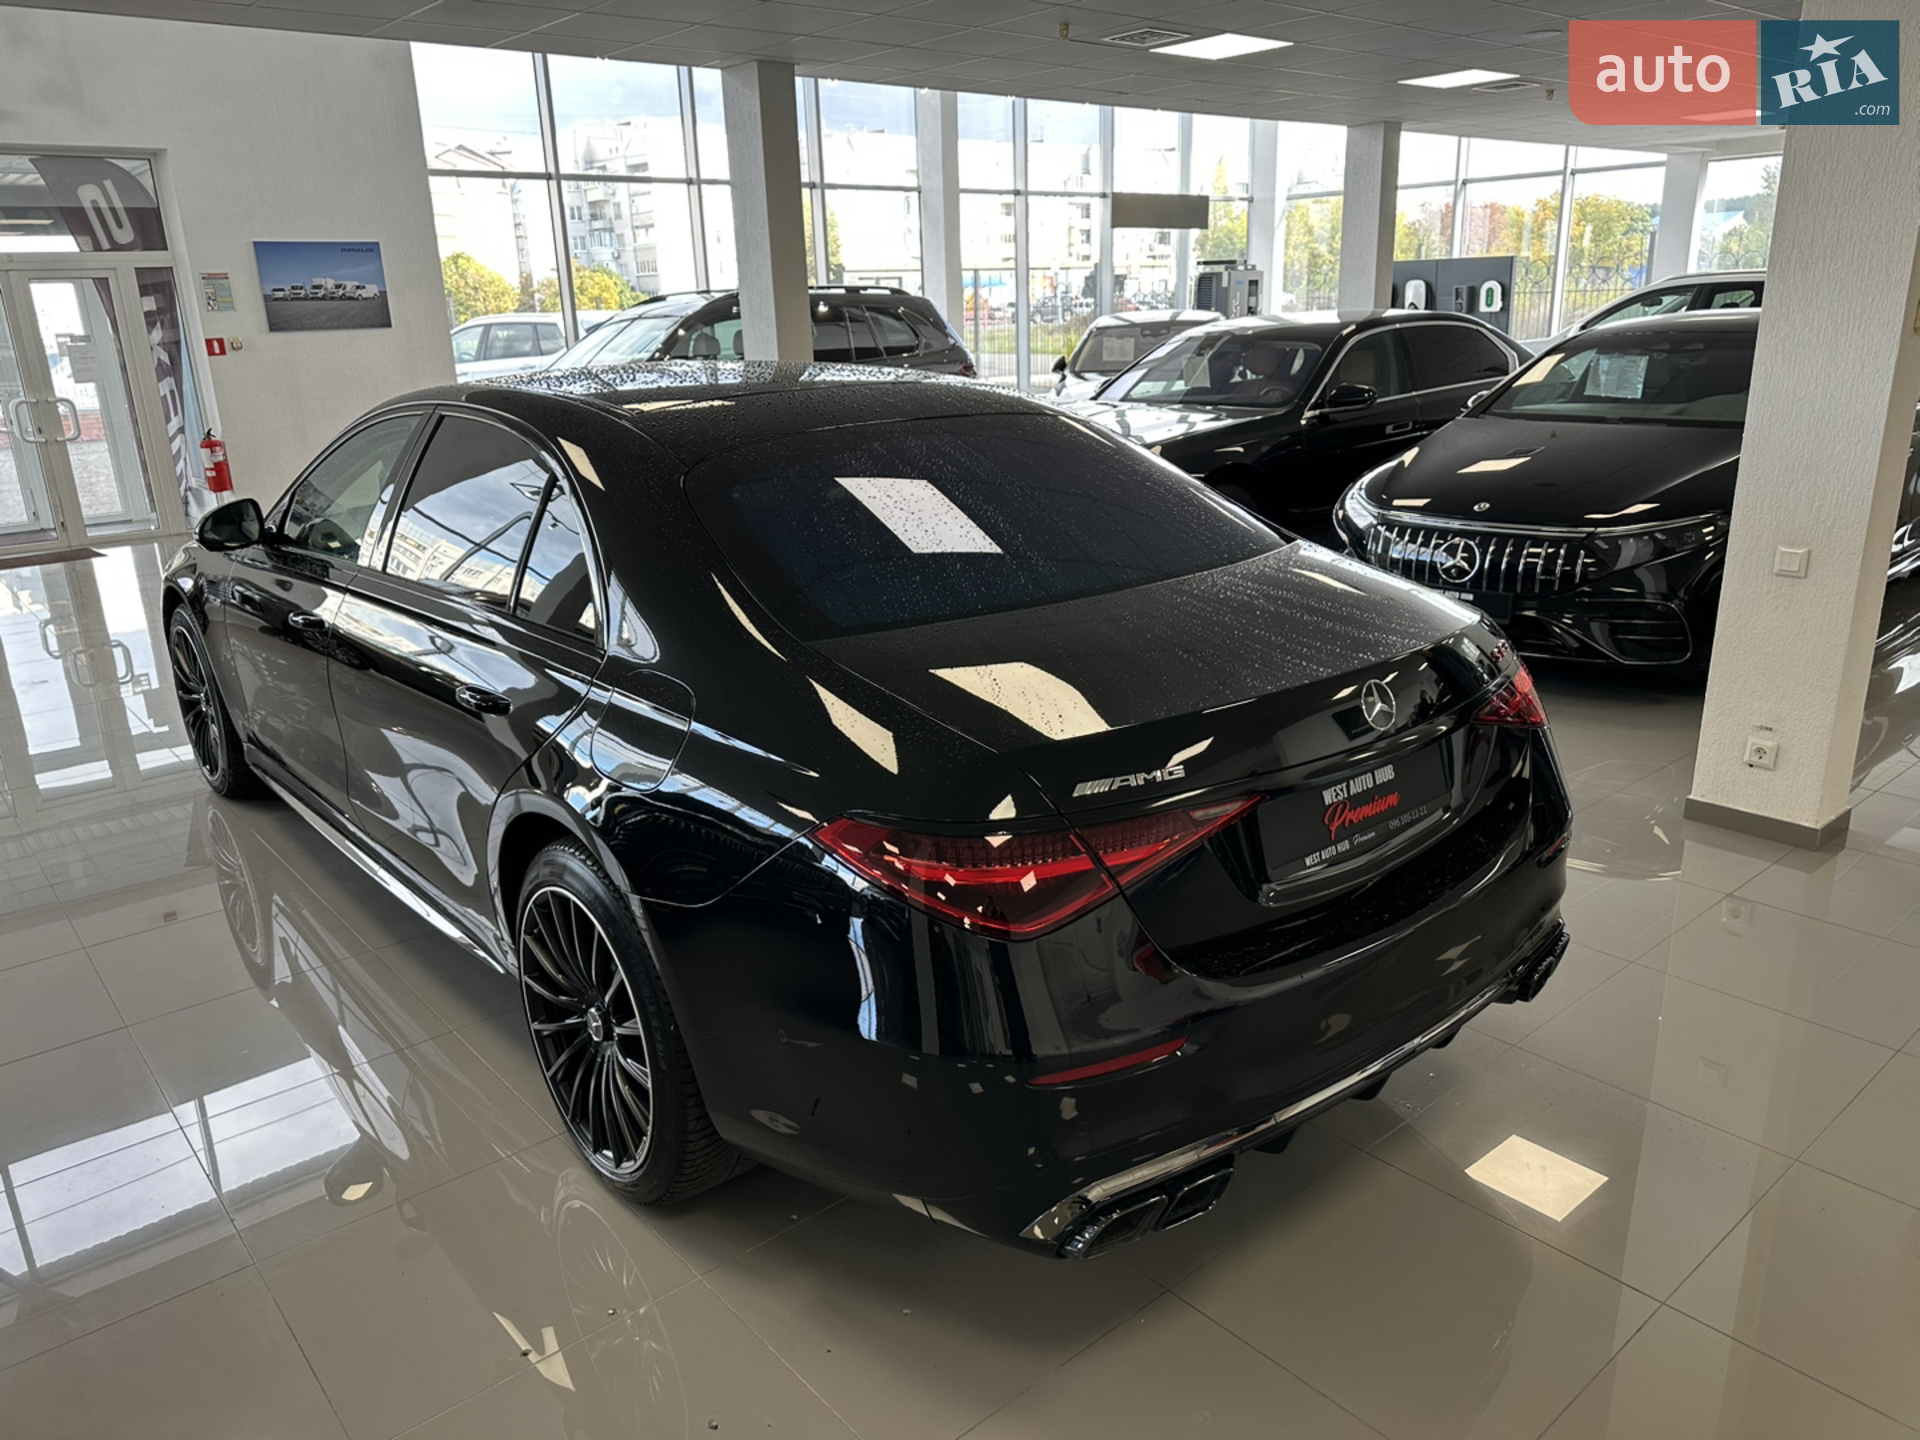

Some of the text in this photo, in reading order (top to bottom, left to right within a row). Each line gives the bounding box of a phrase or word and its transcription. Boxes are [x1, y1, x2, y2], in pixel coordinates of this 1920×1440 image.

[1111, 765, 1186, 790] AMG
[1322, 764, 1396, 806] WEST AUTO HUB
[1324, 791, 1401, 841] Premium
[1304, 851, 1321, 867] WEST
[1320, 845, 1337, 861] AUTO
[1336, 839, 1350, 854] HUB
